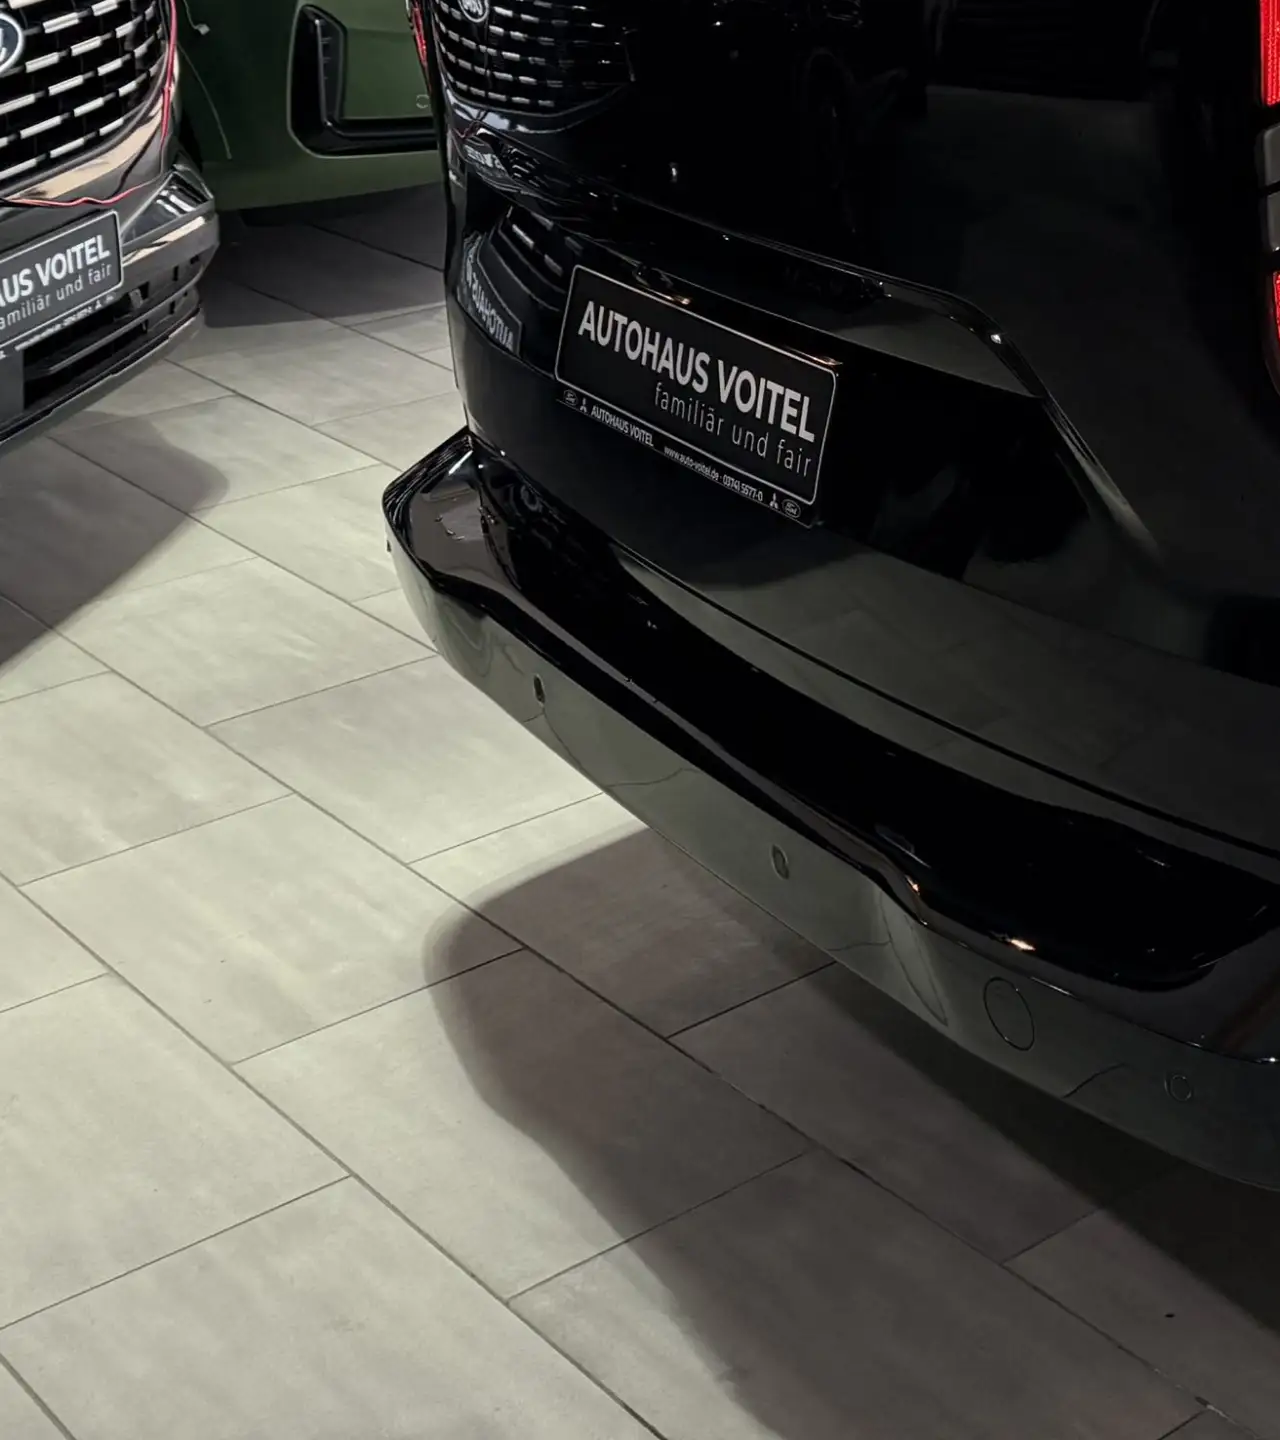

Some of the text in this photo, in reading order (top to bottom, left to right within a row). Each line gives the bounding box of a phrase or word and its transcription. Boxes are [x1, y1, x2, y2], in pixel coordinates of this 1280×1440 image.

[35, 234, 111, 287] VOITEL
[56, 274, 83, 301] und
[88, 263, 112, 285] fair
[577, 301, 815, 443] AUTOHAUS VOITEL
[591, 405, 654, 447] AUTOHAUS VOITEL
[654, 382, 812, 478] familiär und fair
